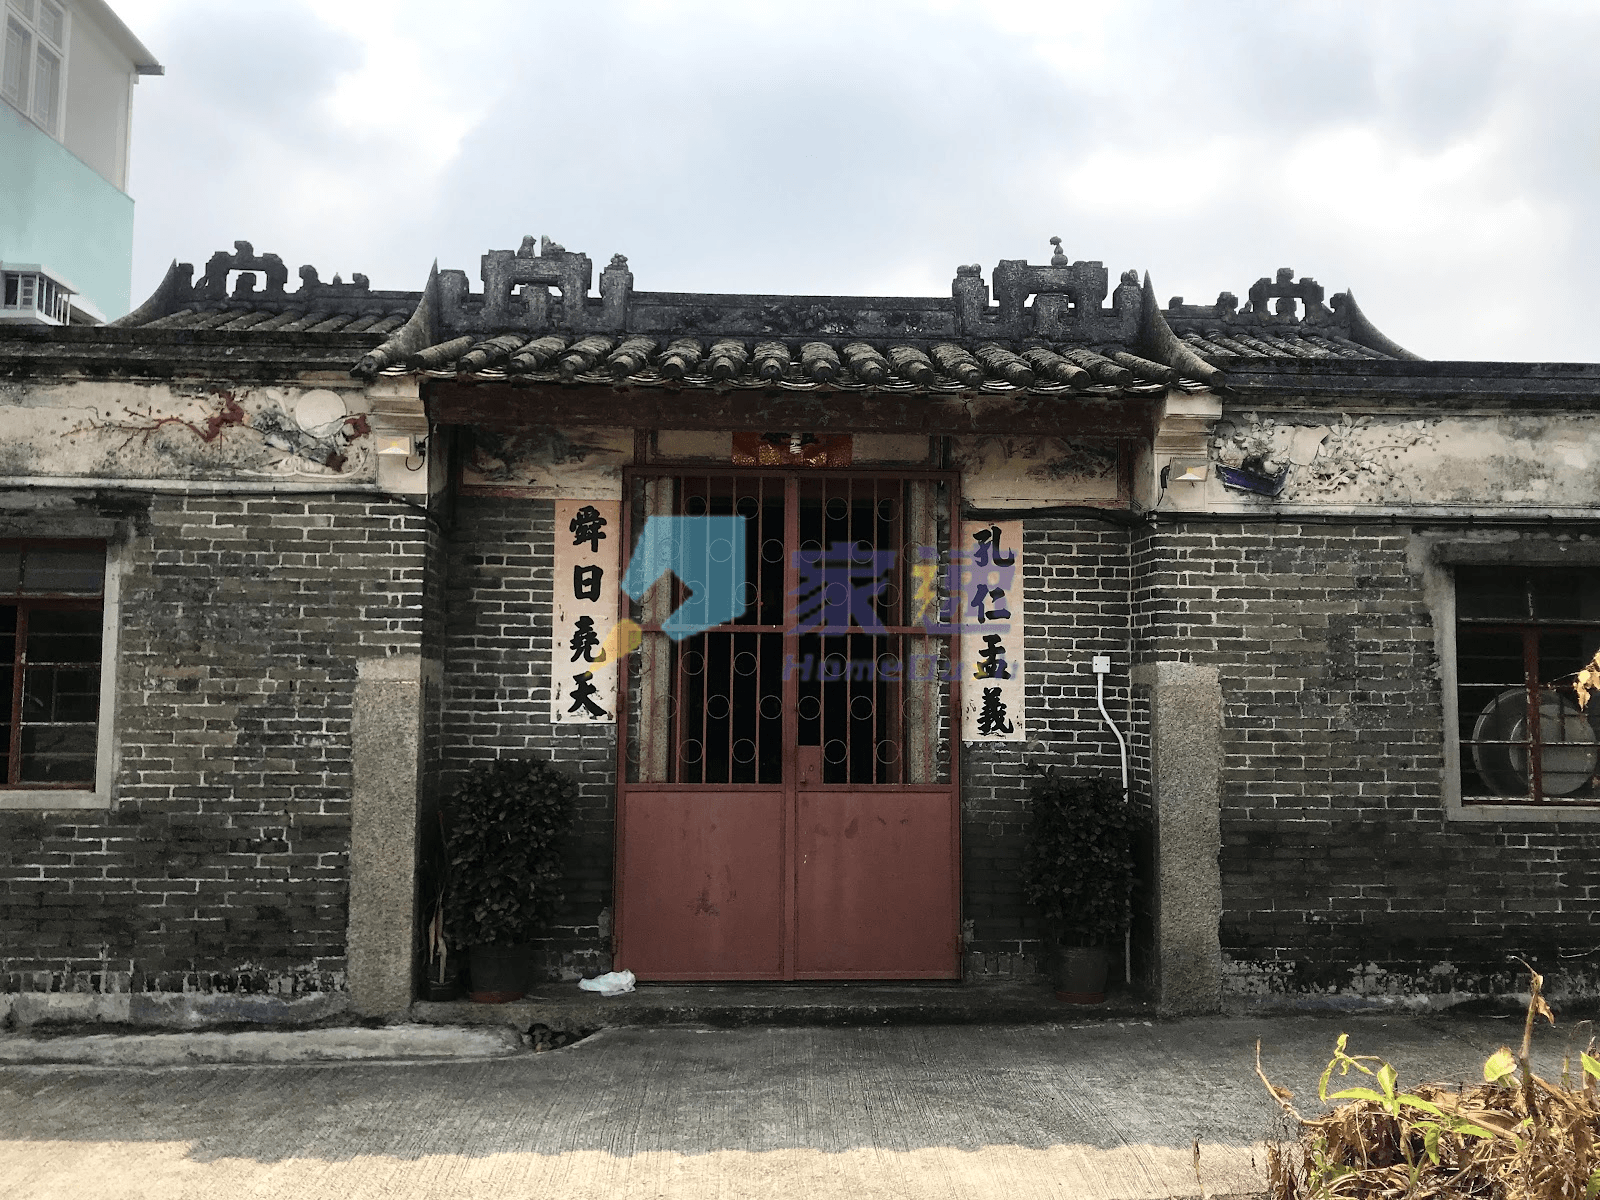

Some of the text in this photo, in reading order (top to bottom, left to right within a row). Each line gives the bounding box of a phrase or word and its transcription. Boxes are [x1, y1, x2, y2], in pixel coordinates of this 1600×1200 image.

[569, 505, 608, 717] 舜日堯天
[970, 525, 1015, 736] 孔仁孟義
